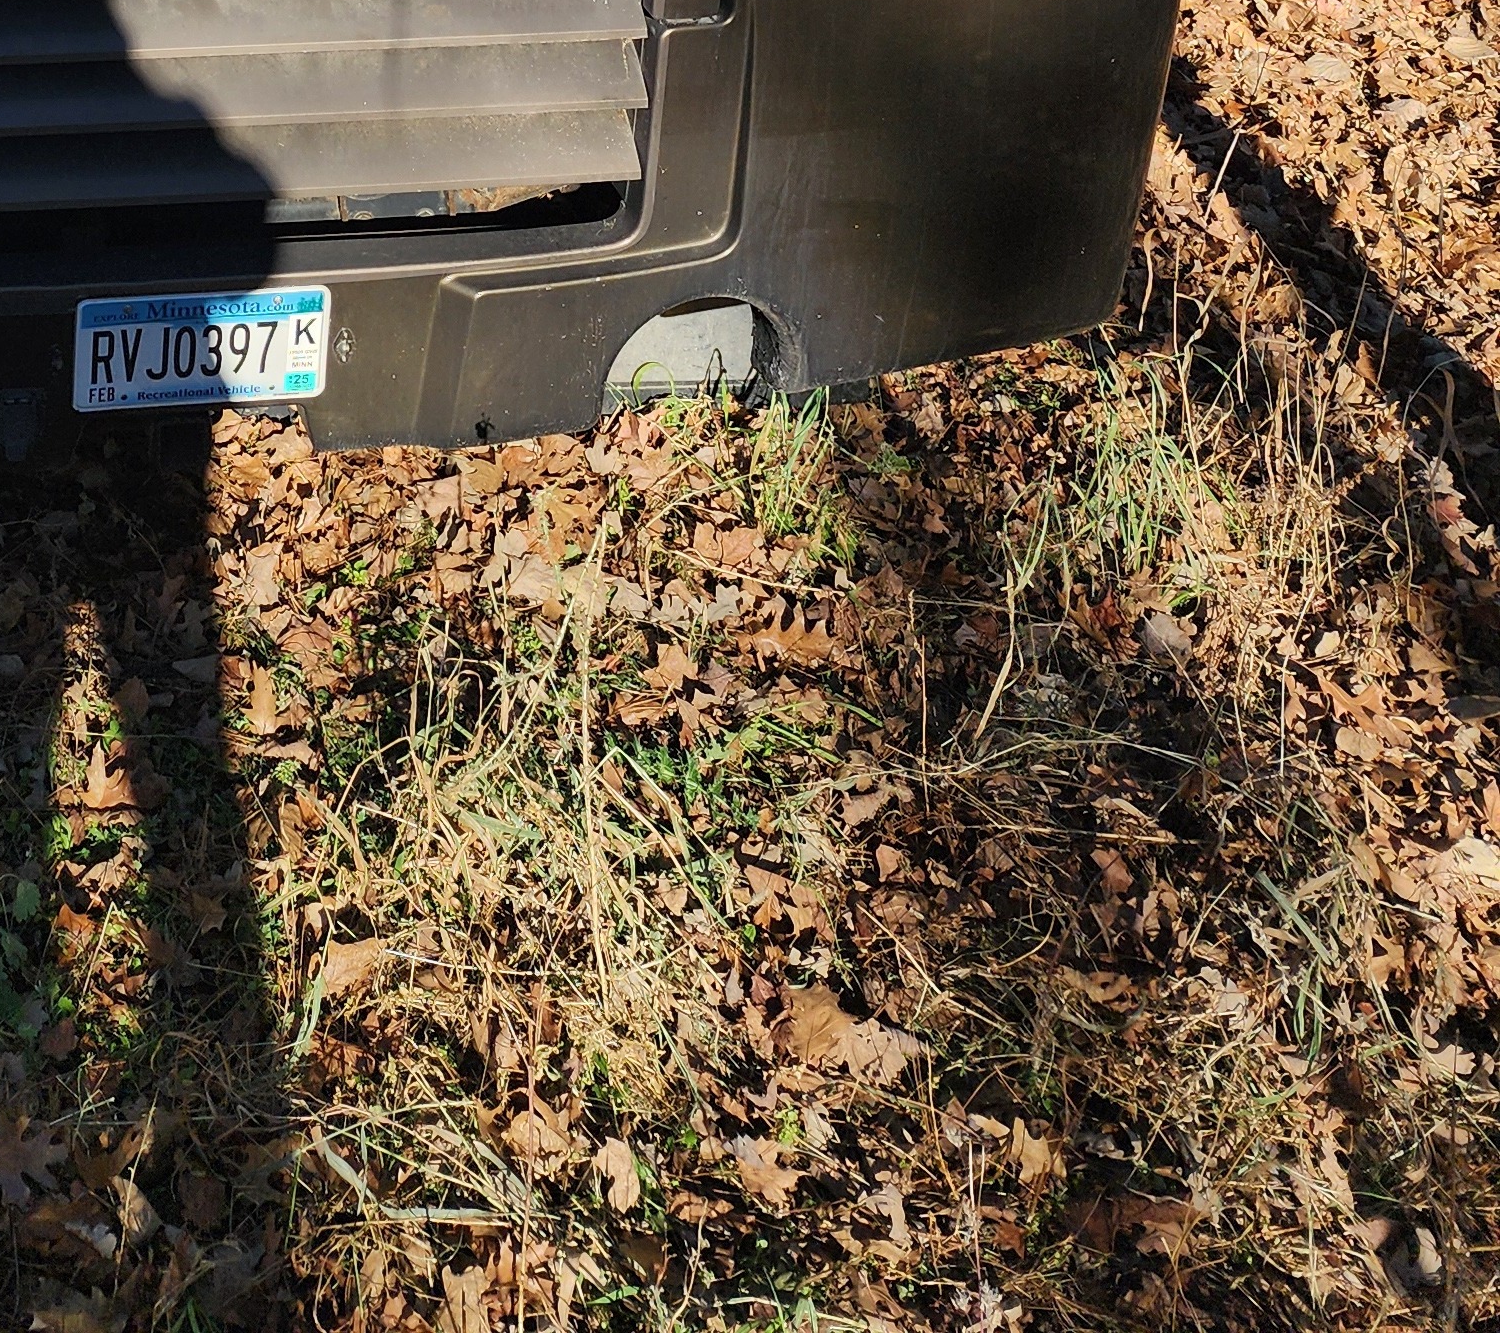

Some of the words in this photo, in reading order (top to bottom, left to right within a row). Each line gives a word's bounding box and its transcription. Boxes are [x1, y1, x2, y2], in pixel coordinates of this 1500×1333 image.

[93, 312, 139, 323] EXPLORE
[146, 300, 294, 320] Minnesota.com
[294, 318, 317, 345] K
[90, 321, 278, 385] RVJ0397
[88, 386, 115, 403] FEB
[137, 385, 214, 401] Recreational
[216, 383, 261, 396] Vehicle
